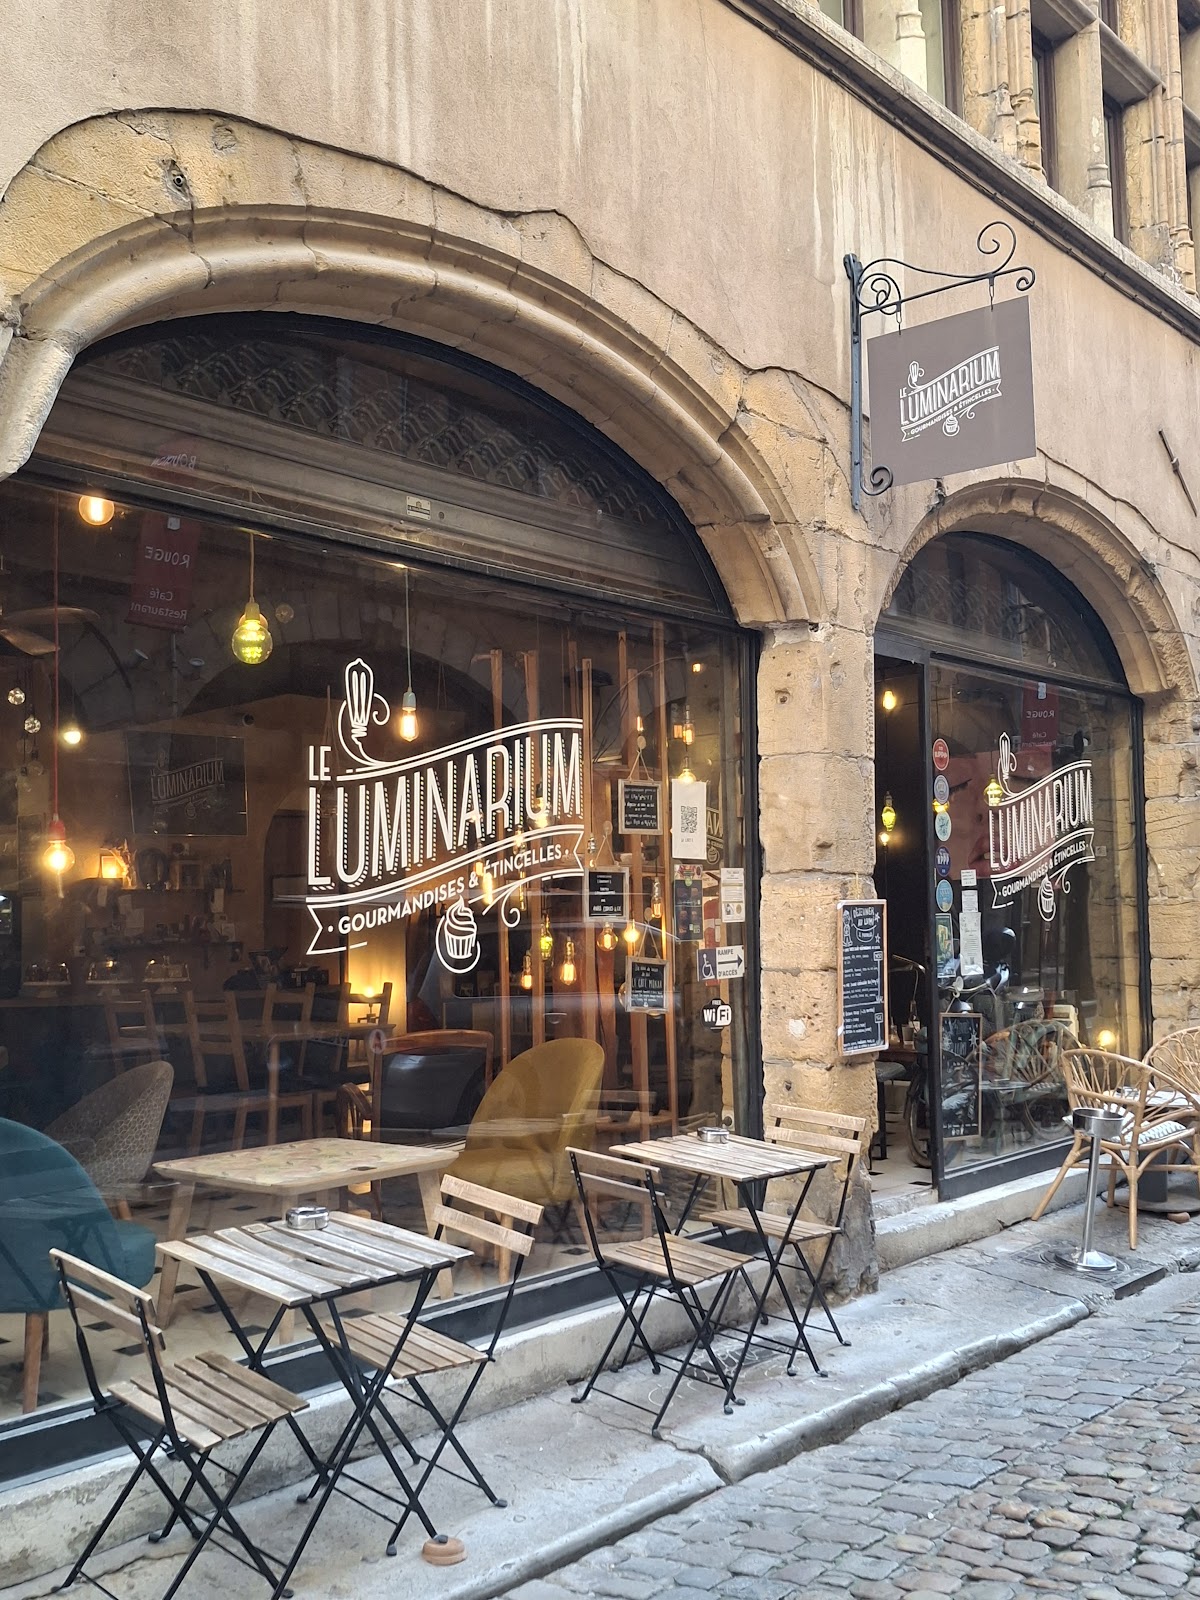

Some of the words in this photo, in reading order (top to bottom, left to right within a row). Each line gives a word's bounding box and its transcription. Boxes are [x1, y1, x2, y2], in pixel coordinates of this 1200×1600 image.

[900, 351, 1001, 425] LUMINARIUM
[900, 387, 907, 398] LE
[910, 408, 953, 435] GOURMANDISES
[150, 760, 225, 800] LUMINARIUM
[309, 745, 332, 781] LE
[307, 732, 584, 890] LUMINARIUM
[989, 769, 1093, 870] LUMINARIUM
[338, 876, 465, 935] GOURMANDISES
[469, 871, 479, 889] &
[484, 844, 562, 880] ÉTINCELLES
[1002, 863, 1049, 897] GOURMANDISES
[1054, 840, 1086, 866] ÉTINCELLES
